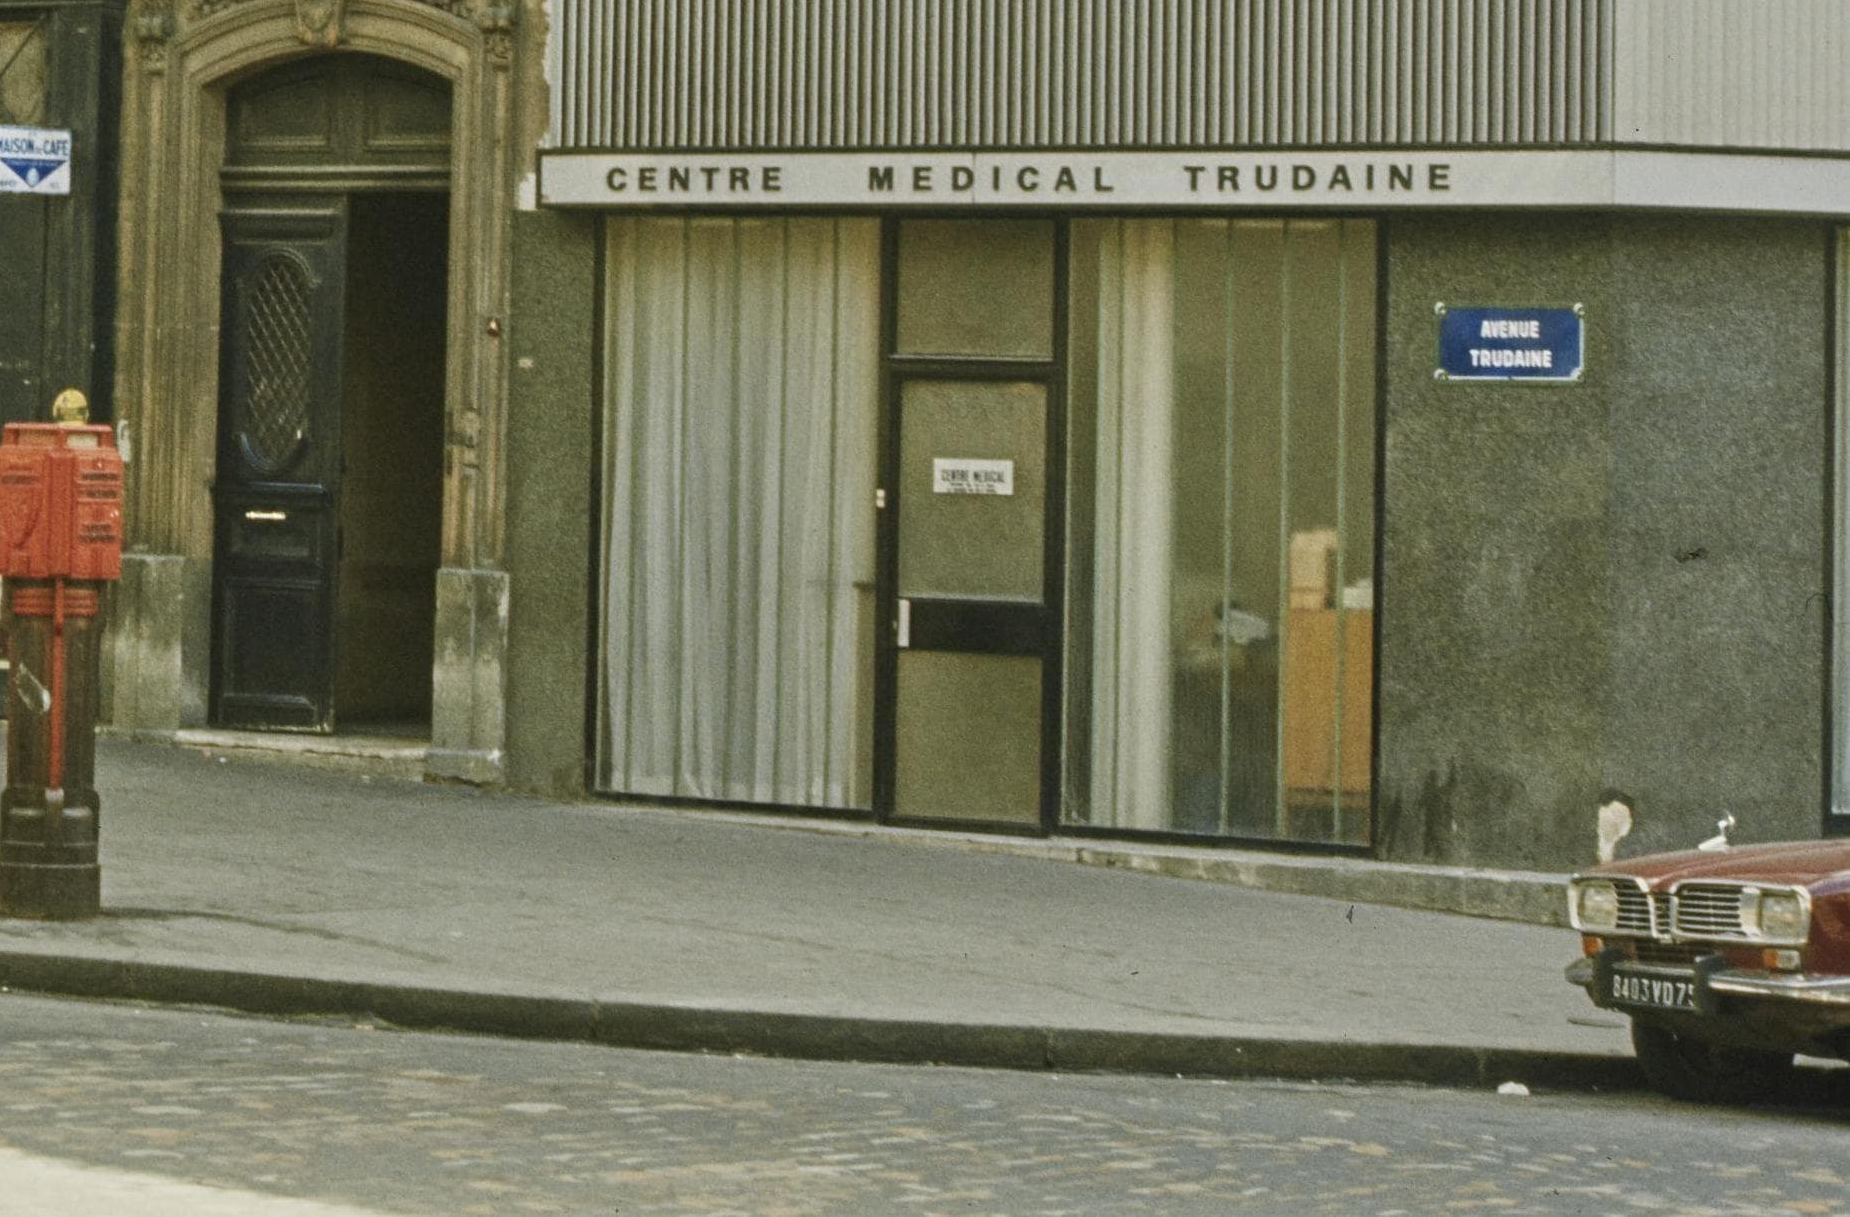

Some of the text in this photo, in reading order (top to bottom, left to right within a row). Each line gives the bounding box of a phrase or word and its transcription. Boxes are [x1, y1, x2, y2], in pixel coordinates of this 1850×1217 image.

[606, 162, 1452, 193] CENTRE MEDICAL TRUDAINE
[1480, 320, 1541, 338] AVENUE
[1469, 348, 1553, 368] TRUDAINE
[940, 469, 1005, 483] CENTRE MEDICAL
